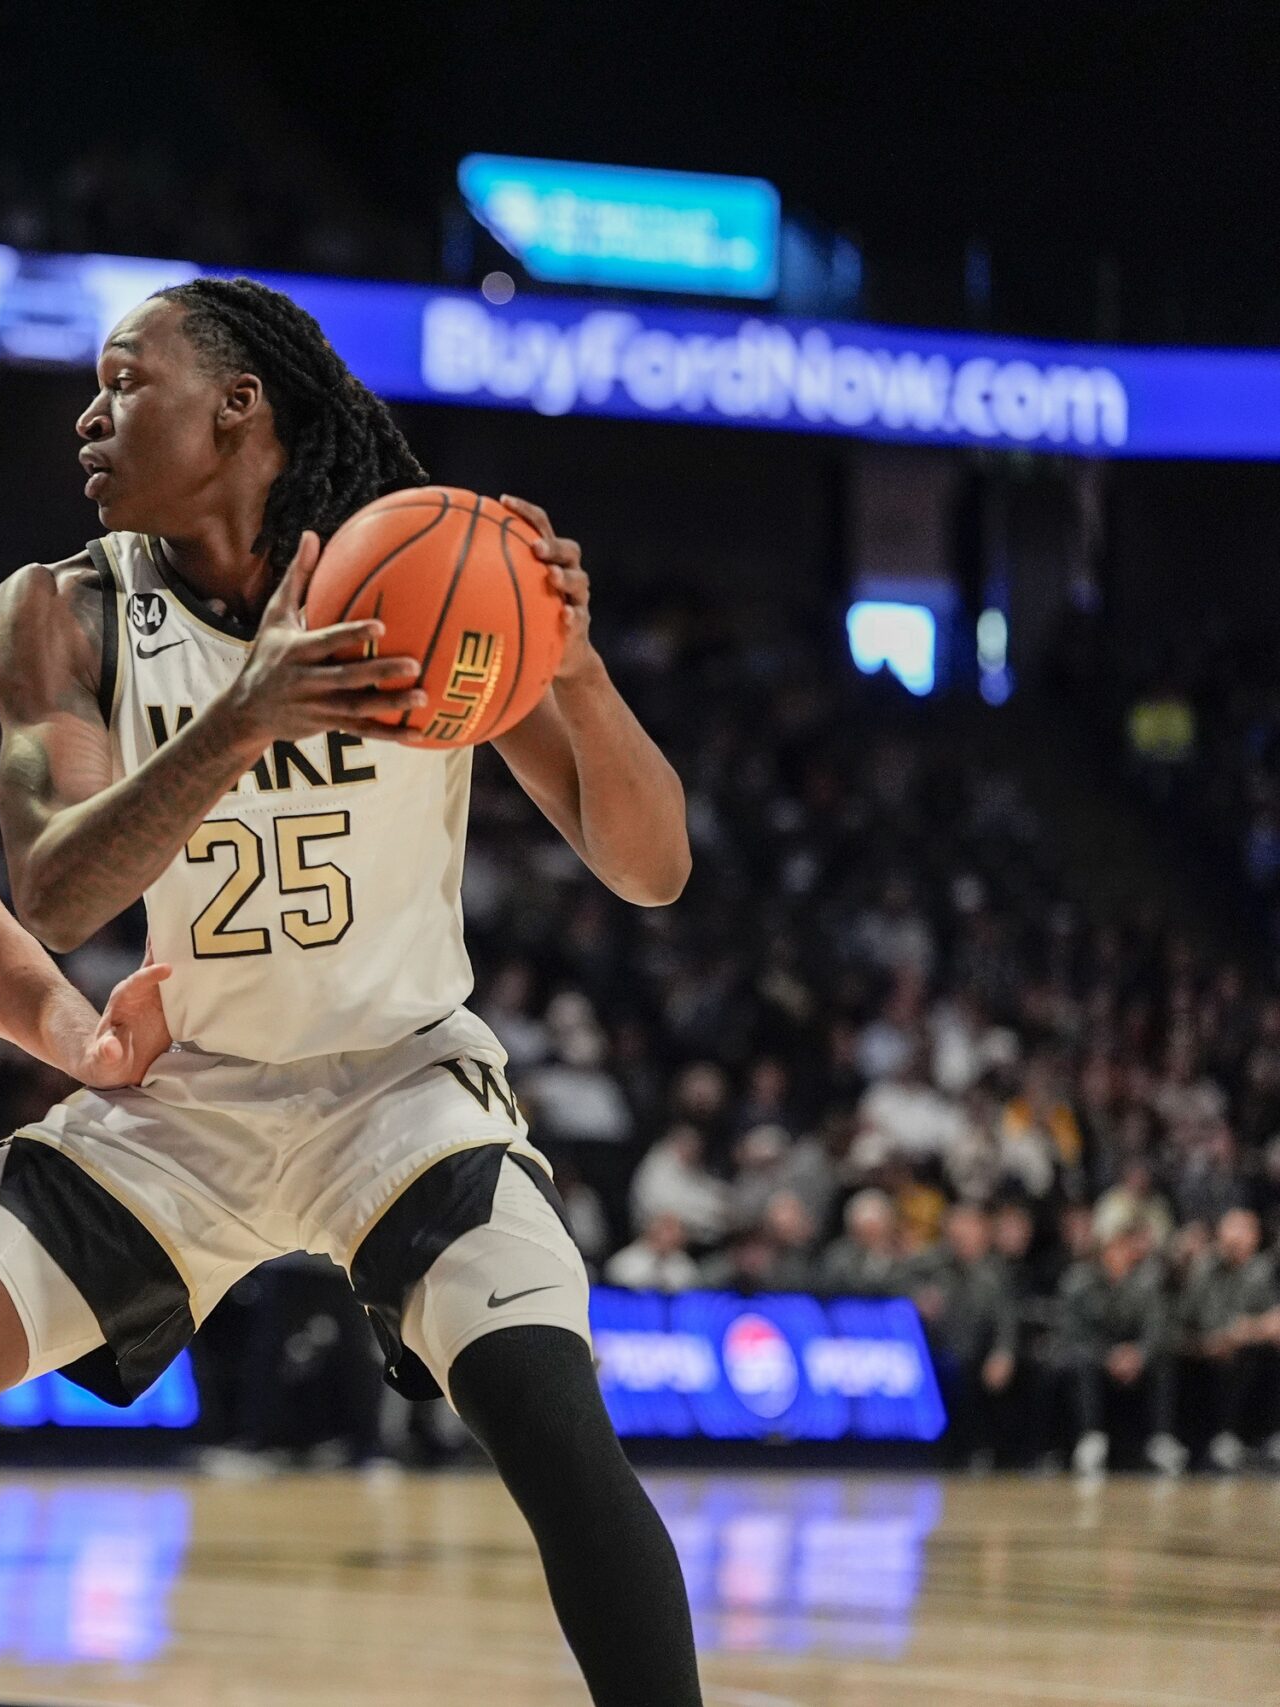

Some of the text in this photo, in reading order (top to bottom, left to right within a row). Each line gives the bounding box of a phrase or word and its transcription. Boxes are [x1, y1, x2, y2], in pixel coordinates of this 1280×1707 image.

[420, 298, 1131, 448] BuyFordNow.com
[132, 594, 162, 627] 54
[422, 629, 496, 742] ELITE
[144, 703, 378, 795] KE
[185, 810, 354, 960] 25
[432, 1057, 518, 1127] W
